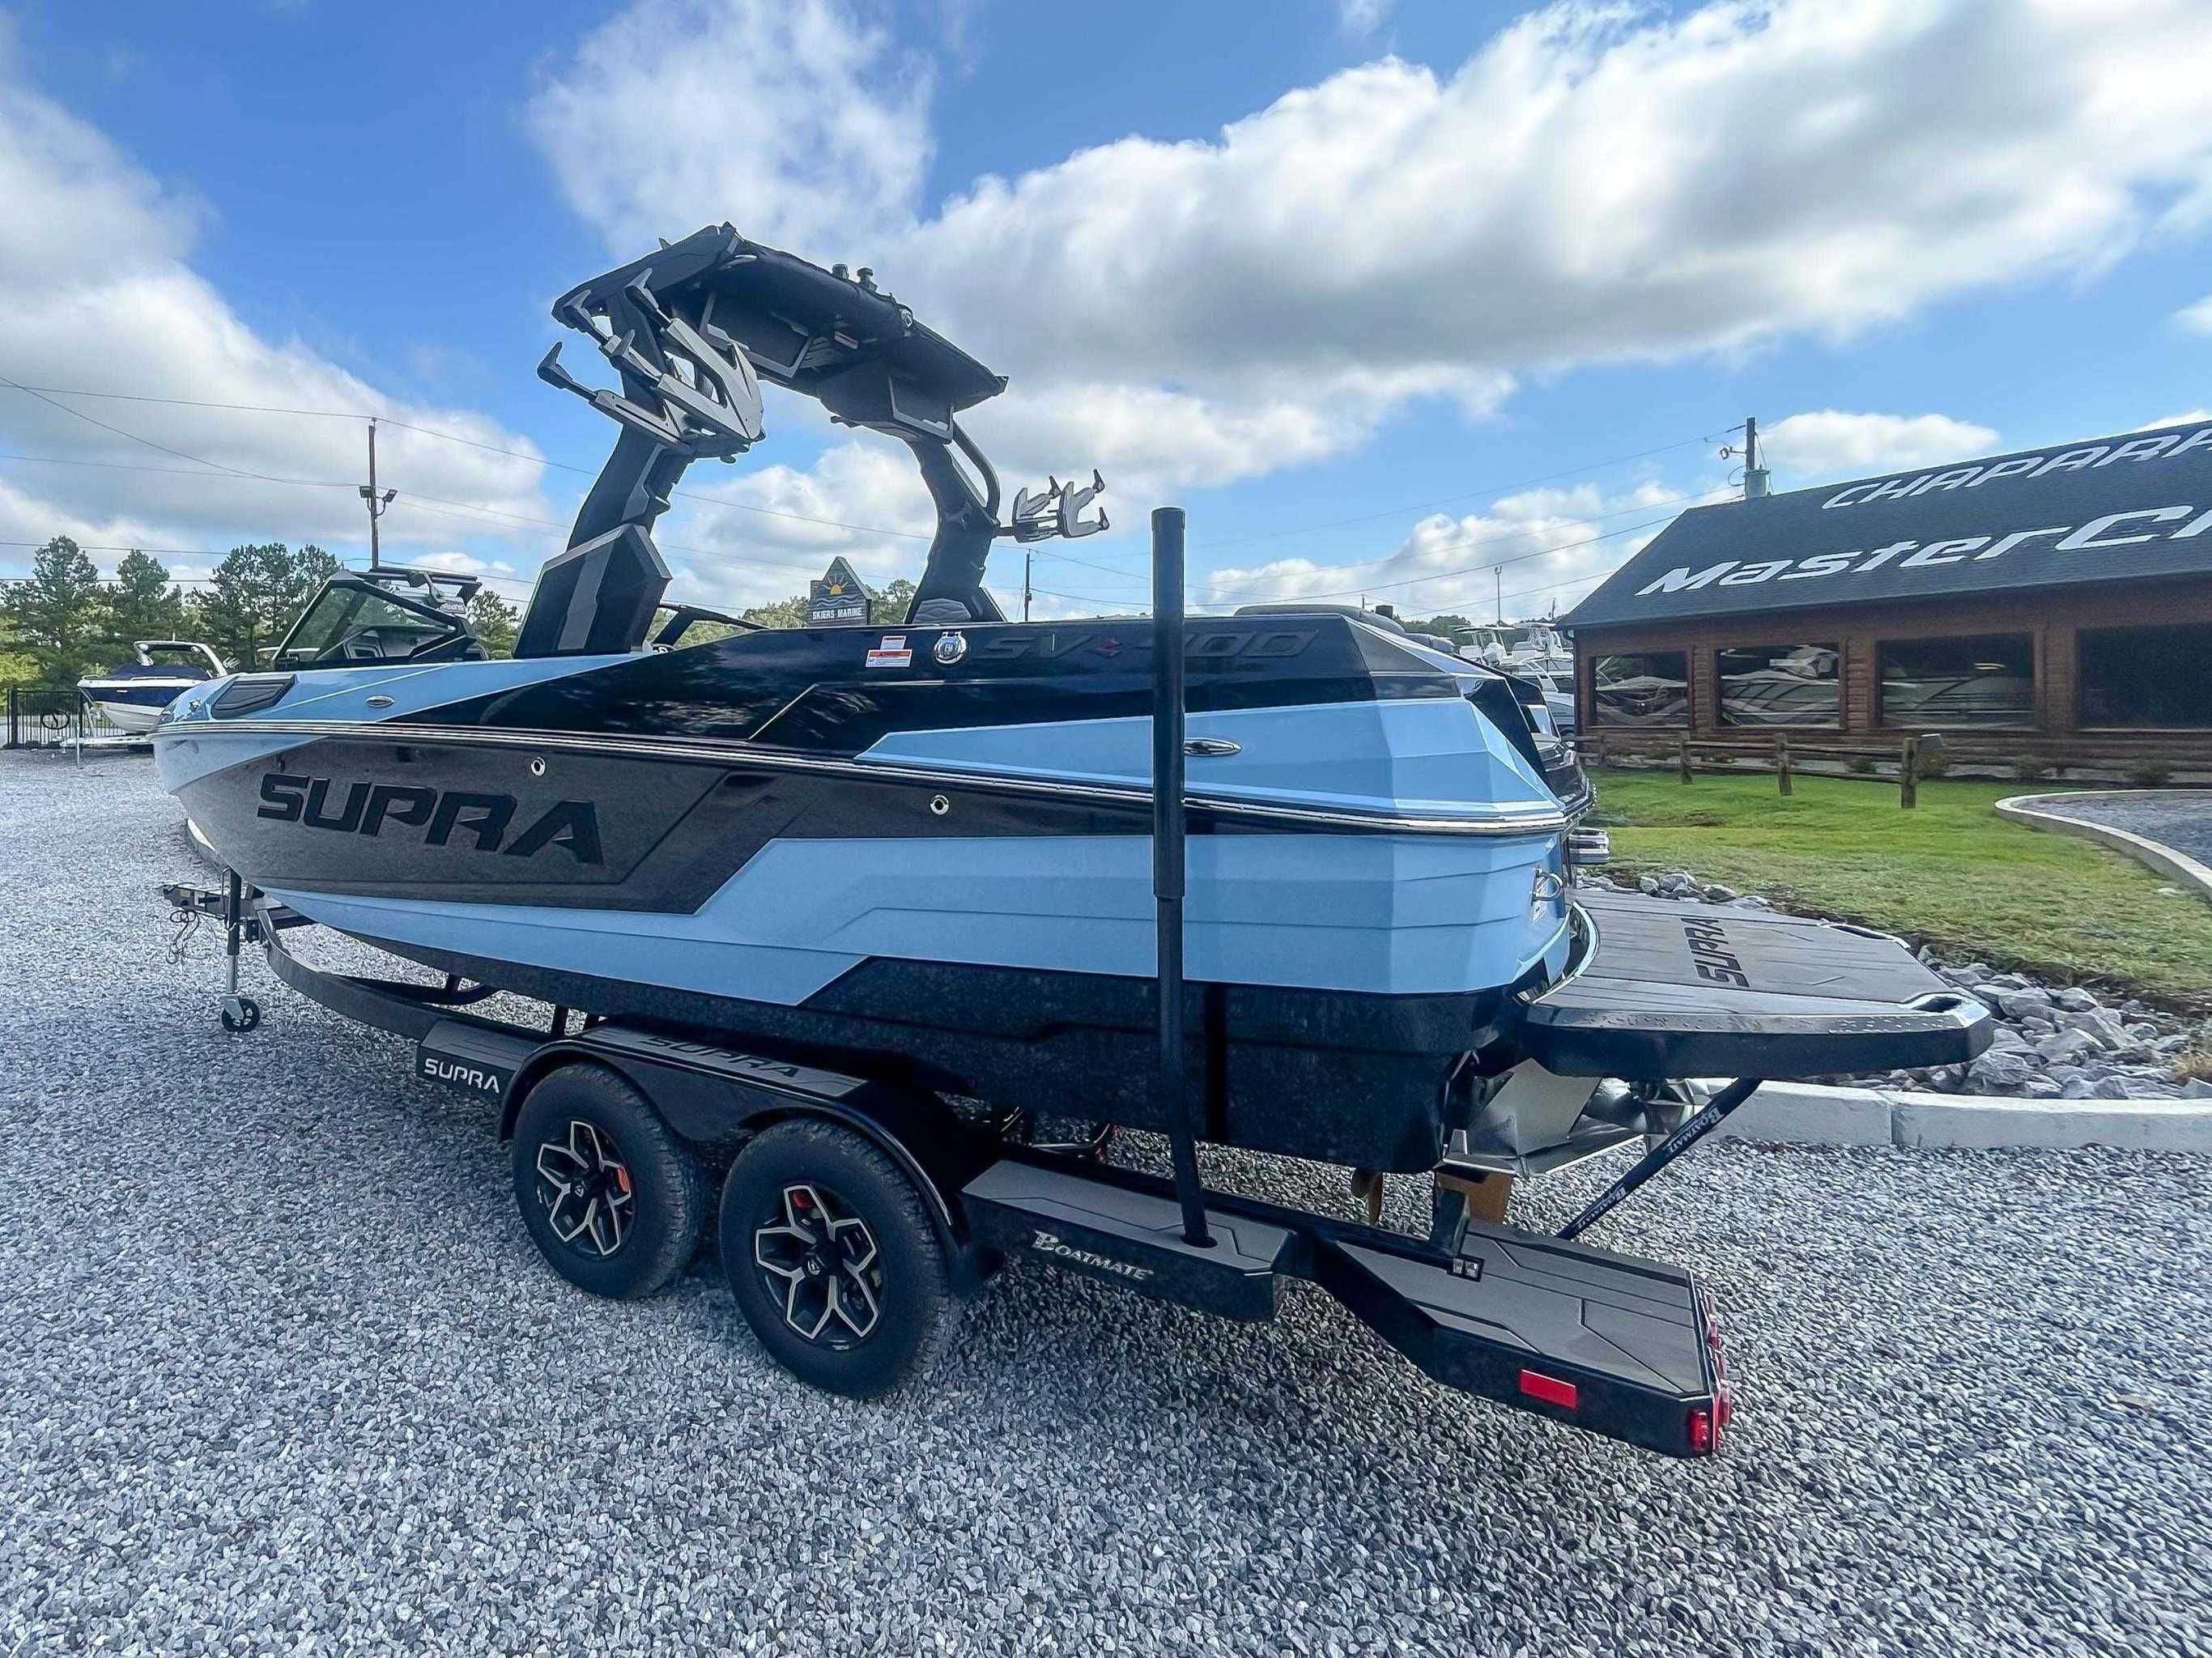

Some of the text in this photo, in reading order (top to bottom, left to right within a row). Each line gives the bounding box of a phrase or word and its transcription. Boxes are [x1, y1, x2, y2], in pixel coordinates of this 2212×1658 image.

[812, 607, 862, 620] SKIERS MARINE
[257, 773, 605, 866] SUPRA
[1680, 917, 1750, 988] SUPRA
[423, 1057, 500, 1094] SUPRA
[636, 1036, 800, 1078] SUPRA
[1032, 1229, 1150, 1281] BOATMATE
